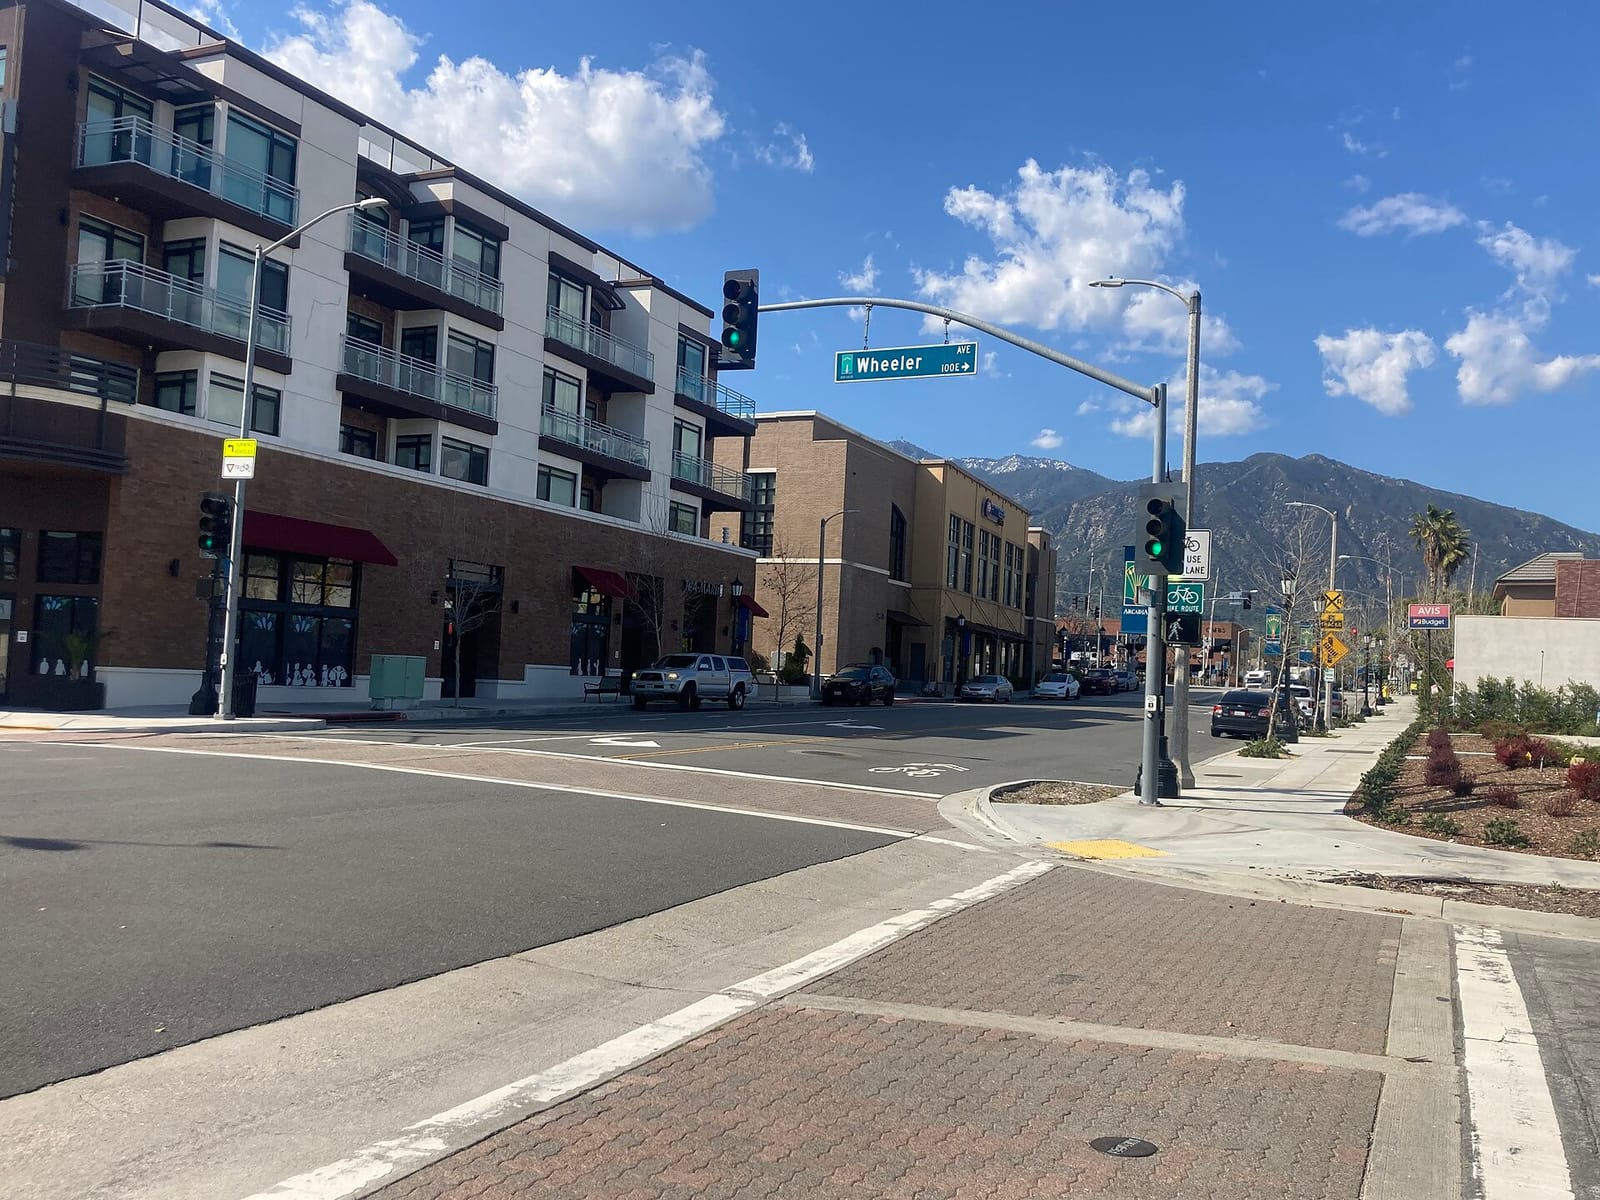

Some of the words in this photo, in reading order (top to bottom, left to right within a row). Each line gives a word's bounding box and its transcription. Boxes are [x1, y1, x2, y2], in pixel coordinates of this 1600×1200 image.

[956, 345, 971, 354] AVE
[856, 355, 922, 374] Wheeler
[941, 362, 960, 373] 100E
[1186, 555, 1202, 564] USE
[1185, 566, 1205, 575] LANE
[1417, 606, 1441, 615] AVIS
[1421, 618, 1445, 627] Budget
